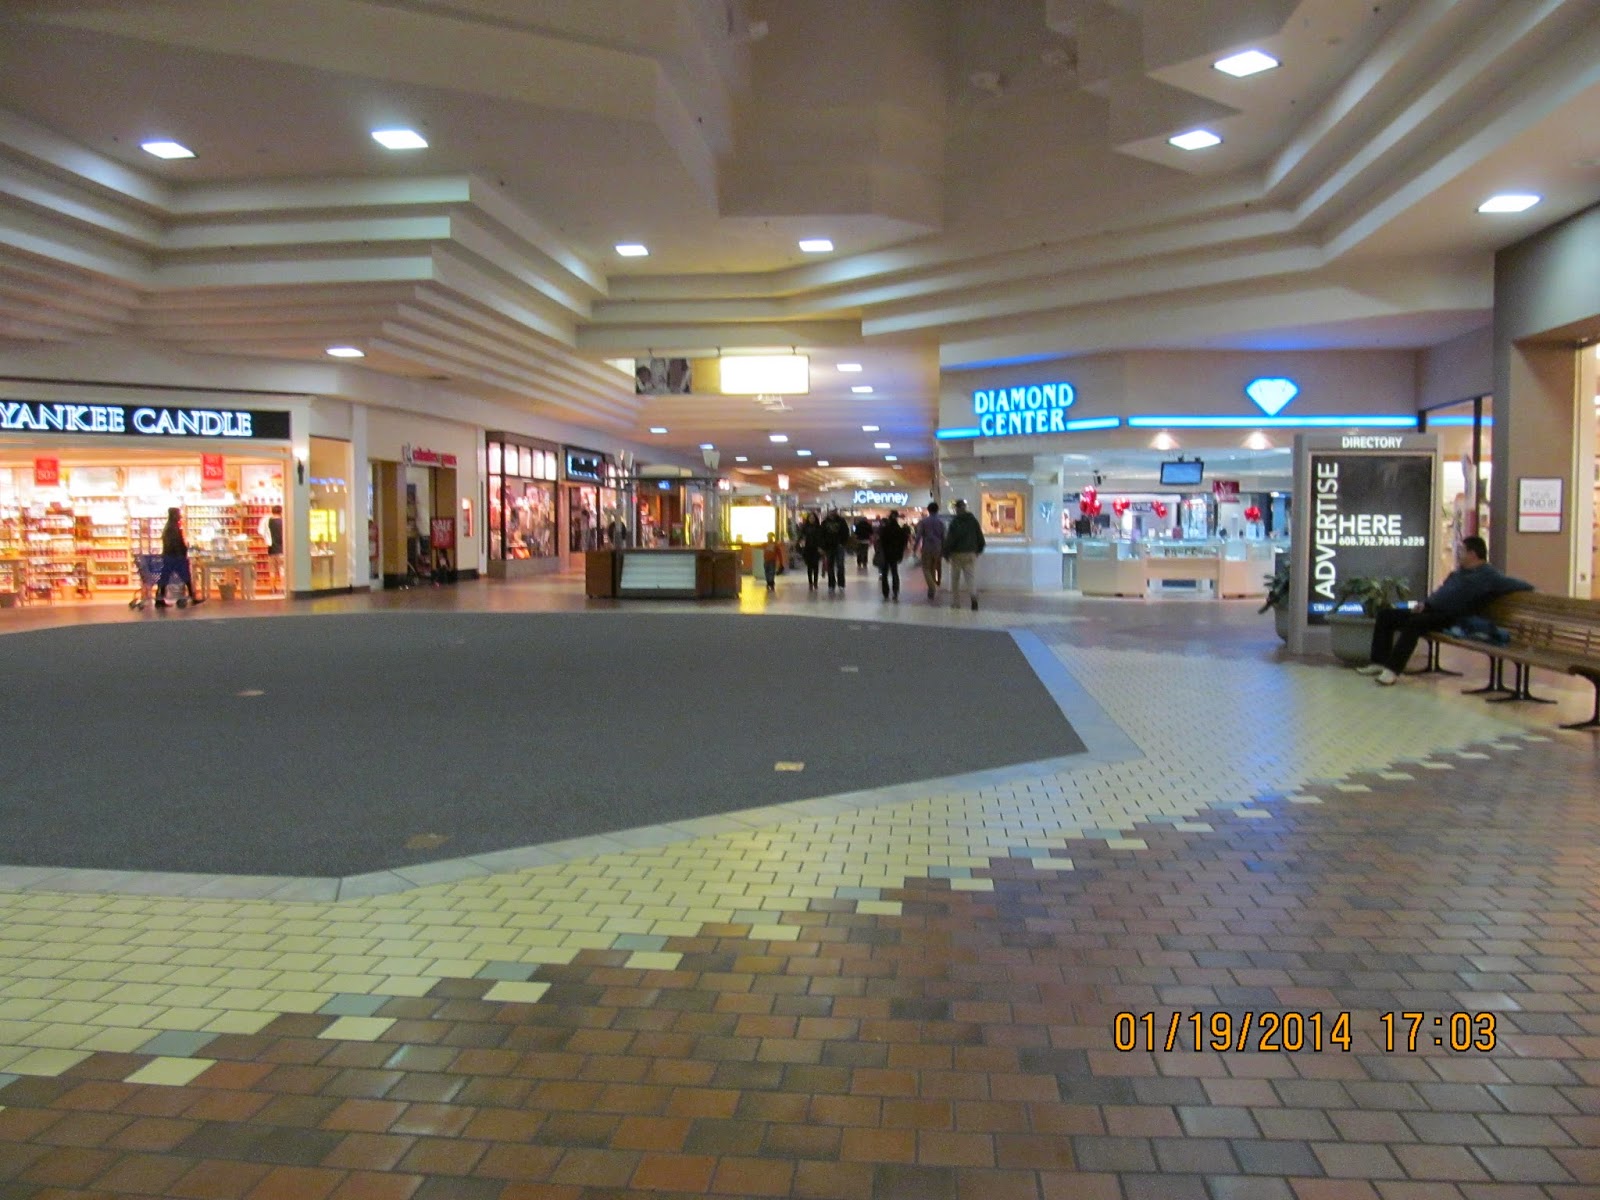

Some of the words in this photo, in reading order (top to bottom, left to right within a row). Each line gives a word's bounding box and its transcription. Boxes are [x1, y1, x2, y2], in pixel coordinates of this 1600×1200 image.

[974, 382, 1075, 415] DIAMOND
[0, 402, 125, 432] YANKEE
[132, 408, 252, 437] CANDLE
[980, 408, 1066, 437] CENTER
[1342, 435, 1403, 449] DIRECTORY
[853, 490, 908, 506] JCPenney
[1314, 462, 1339, 599] ADVERTISE
[1339, 513, 1402, 535] HERE
